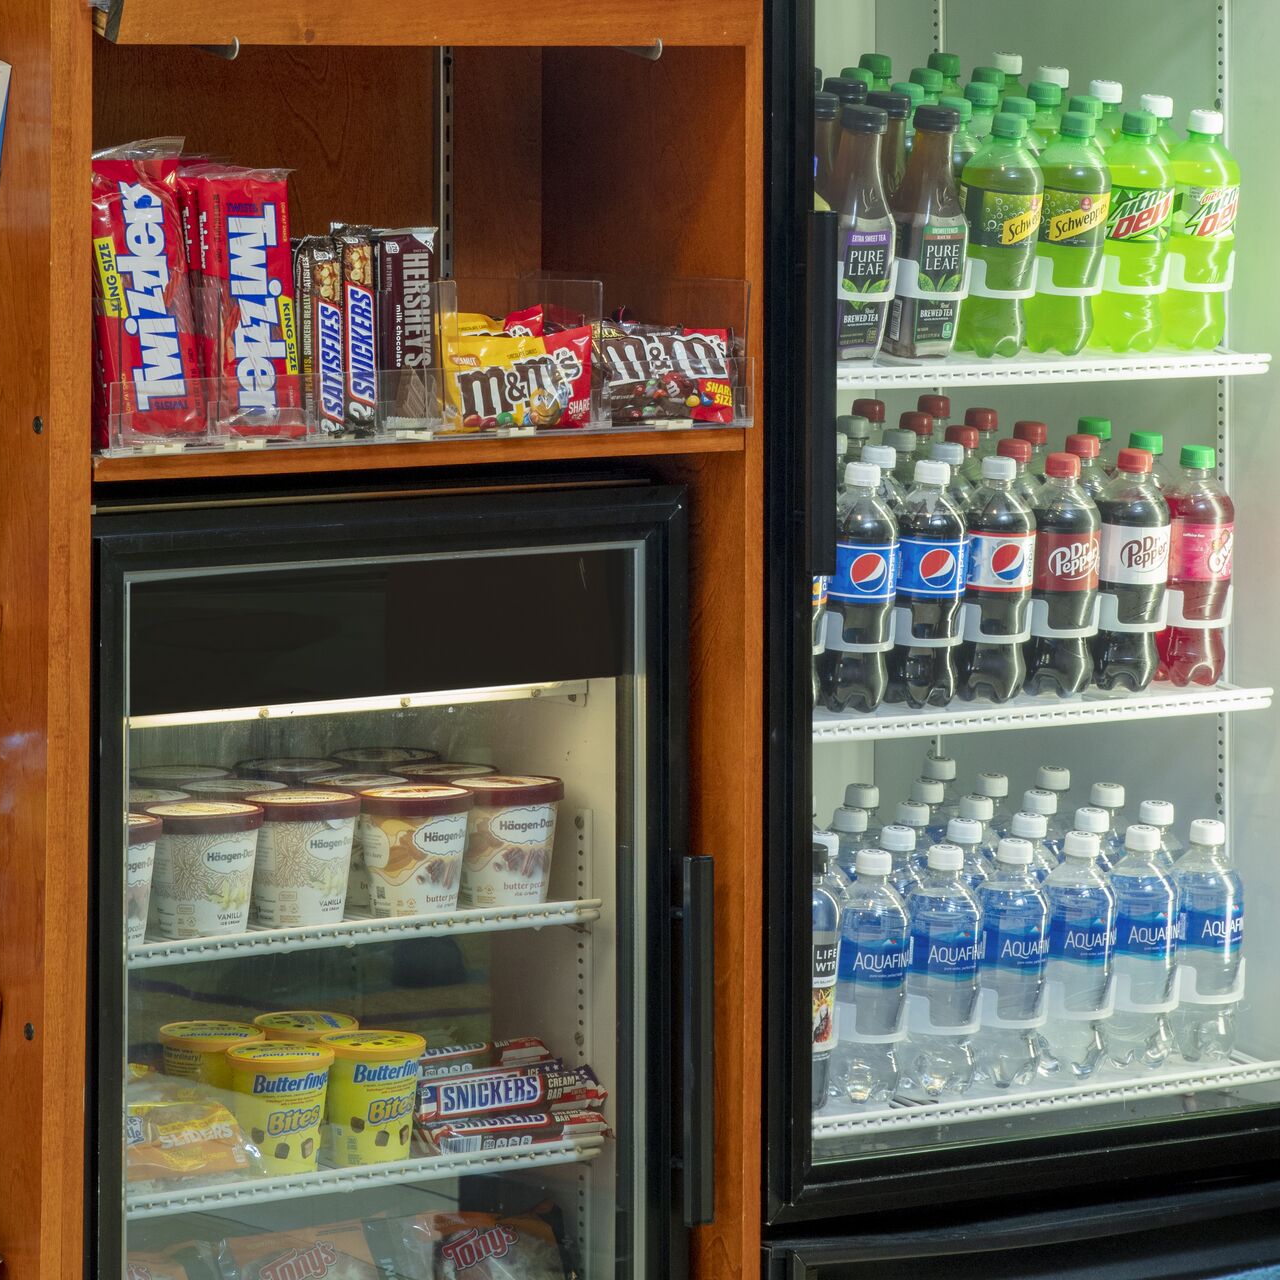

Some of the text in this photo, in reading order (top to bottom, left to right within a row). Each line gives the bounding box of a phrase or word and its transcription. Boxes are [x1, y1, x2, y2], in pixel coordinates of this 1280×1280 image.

[878, 234, 886, 242] TEA
[850, 250, 884, 262] PURE
[926, 244, 960, 257] PURE
[98, 242, 122, 313] KING SIZE
[403, 253, 432, 367] HERSHEY'S
[920, 308, 952, 317] BREWED TEA
[844, 314, 878, 323] BREWED TEA
[283, 302, 298, 371] KING SIZE
[350, 289, 375, 400] SNICKERS
[320, 305, 343, 417] SATISFIES
[569, 398, 590, 414] SHARE
[714, 394, 732, 406] SIZE
[349, 402, 370, 419] 2
[1071, 542, 1089, 556] Dr
[1147, 536, 1159, 551] Dr
[1055, 547, 1097, 576] Pepper
[1127, 540, 1167, 568] Pepper
[888, 552, 896, 589] pepsi
[319, 898, 342, 907] VANILLA
[217, 912, 242, 920] VANILLA
[817, 949, 837, 959] LIFE
[816, 962, 836, 972] WTR
[548, 1077, 577, 1087] CREAM
[443, 1076, 540, 1112] SNICKERS
[547, 1089, 563, 1100] BAR
[369, 1092, 415, 1122] Bites
[268, 1105, 320, 1136] Bites
[160, 1122, 233, 1148] SLIDERS
[442, 1224, 519, 1271] Tony's
[259, 1240, 337, 1280] Tony's
